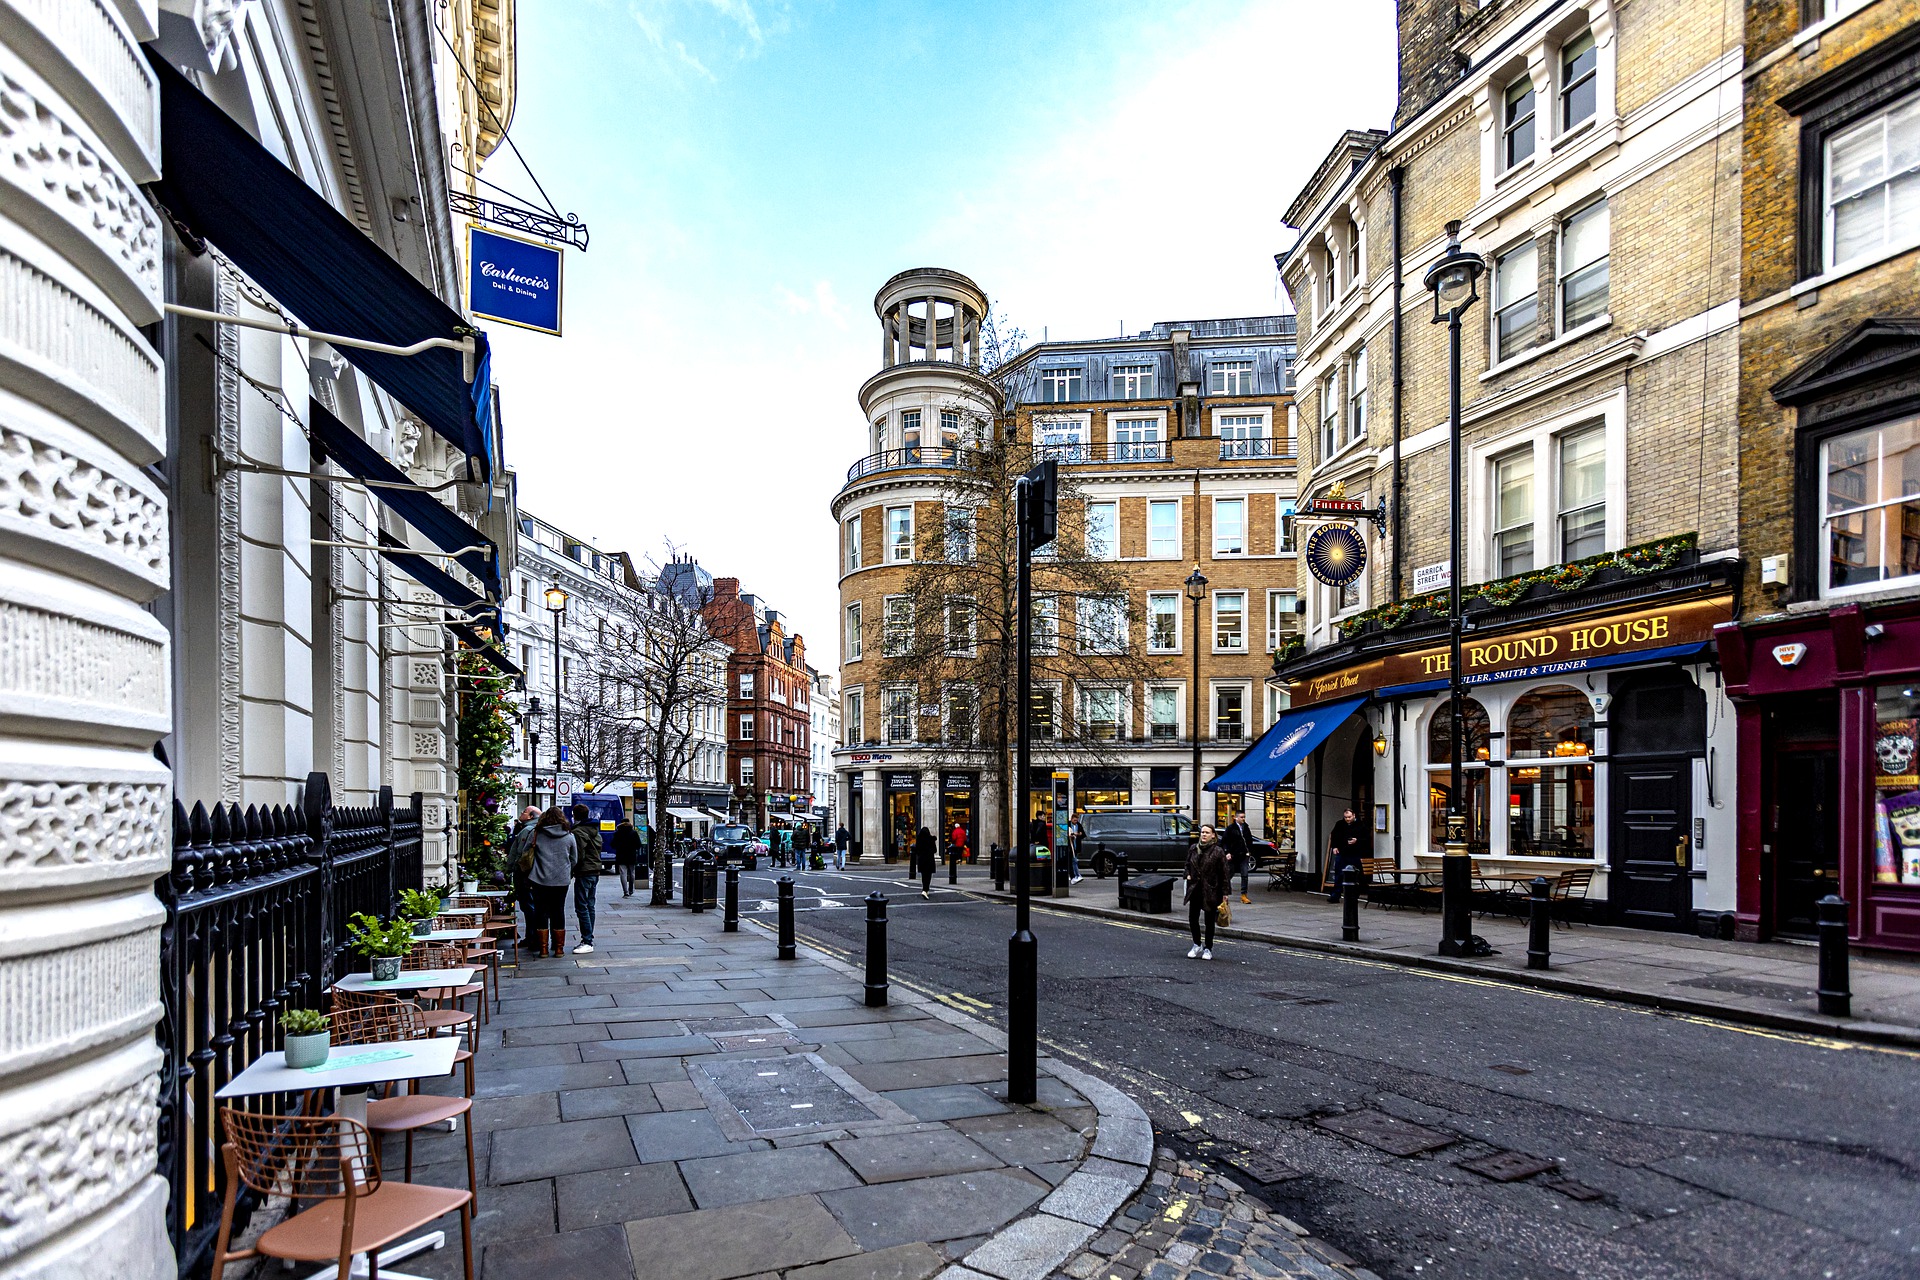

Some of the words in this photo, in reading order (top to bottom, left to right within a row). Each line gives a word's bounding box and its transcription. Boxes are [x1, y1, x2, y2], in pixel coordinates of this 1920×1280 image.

[480, 261, 549, 290] Carluccio's
[492, 282, 506, 290] Deli
[515, 287, 537, 299] Dining
[1308, 536, 1318, 556] THE
[1316, 523, 1348, 537] ROUND
[1349, 529, 1366, 558] HOUSE
[1309, 562, 1335, 586] COVENT
[1337, 564, 1364, 586] GARDEN
[1417, 565, 1444, 578] GARRICK
[1417, 574, 1439, 586] STREET
[1420, 652, 1451, 675] TH
[1469, 635, 1558, 667] ROUND
[1570, 615, 1669, 652] HOUSE
[1340, 672, 1359, 688] Street
[1493, 668, 1527, 681] SMITH
[1529, 667, 1538, 675] &
[1541, 659, 1587, 674] TURNER
